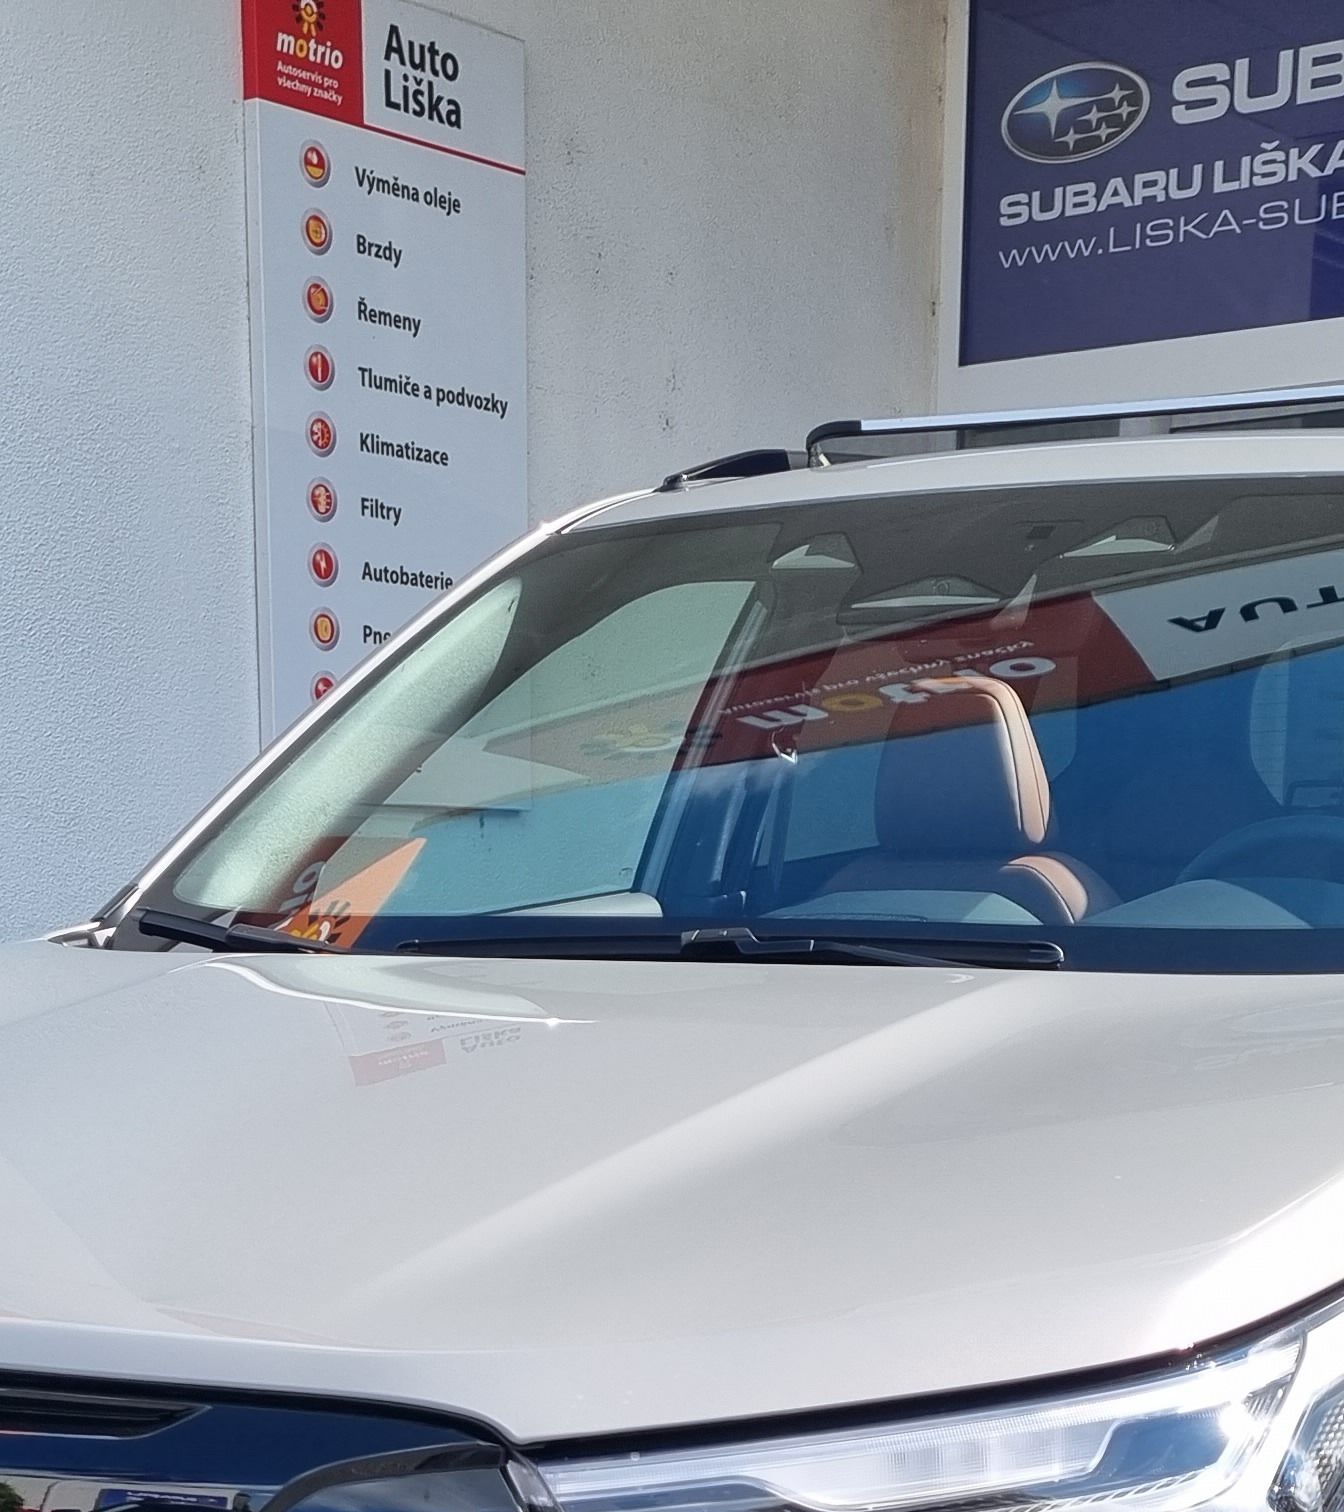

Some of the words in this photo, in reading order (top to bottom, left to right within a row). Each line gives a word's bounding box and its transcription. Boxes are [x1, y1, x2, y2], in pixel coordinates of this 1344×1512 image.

[276, 32, 344, 69] motrio
[384, 24, 459, 82] Auto
[276, 60, 323, 84] Autoservis
[323, 76, 339, 89] pro
[384, 69, 462, 130] Liška
[354, 166, 419, 203] Výměna
[423, 187, 462, 216] oleje
[999, 163, 1202, 227] SUBARU
[356, 234, 403, 268] Brzdy
[357, 296, 422, 338] Řemeny
[358, 366, 420, 398] Tlumiče
[423, 384, 433, 400] a
[436, 387, 509, 419] podvozky
[359, 432, 449, 467] Klimatizace
[360, 497, 402, 527] Filtry
[361, 562, 454, 591] Autobaterie
